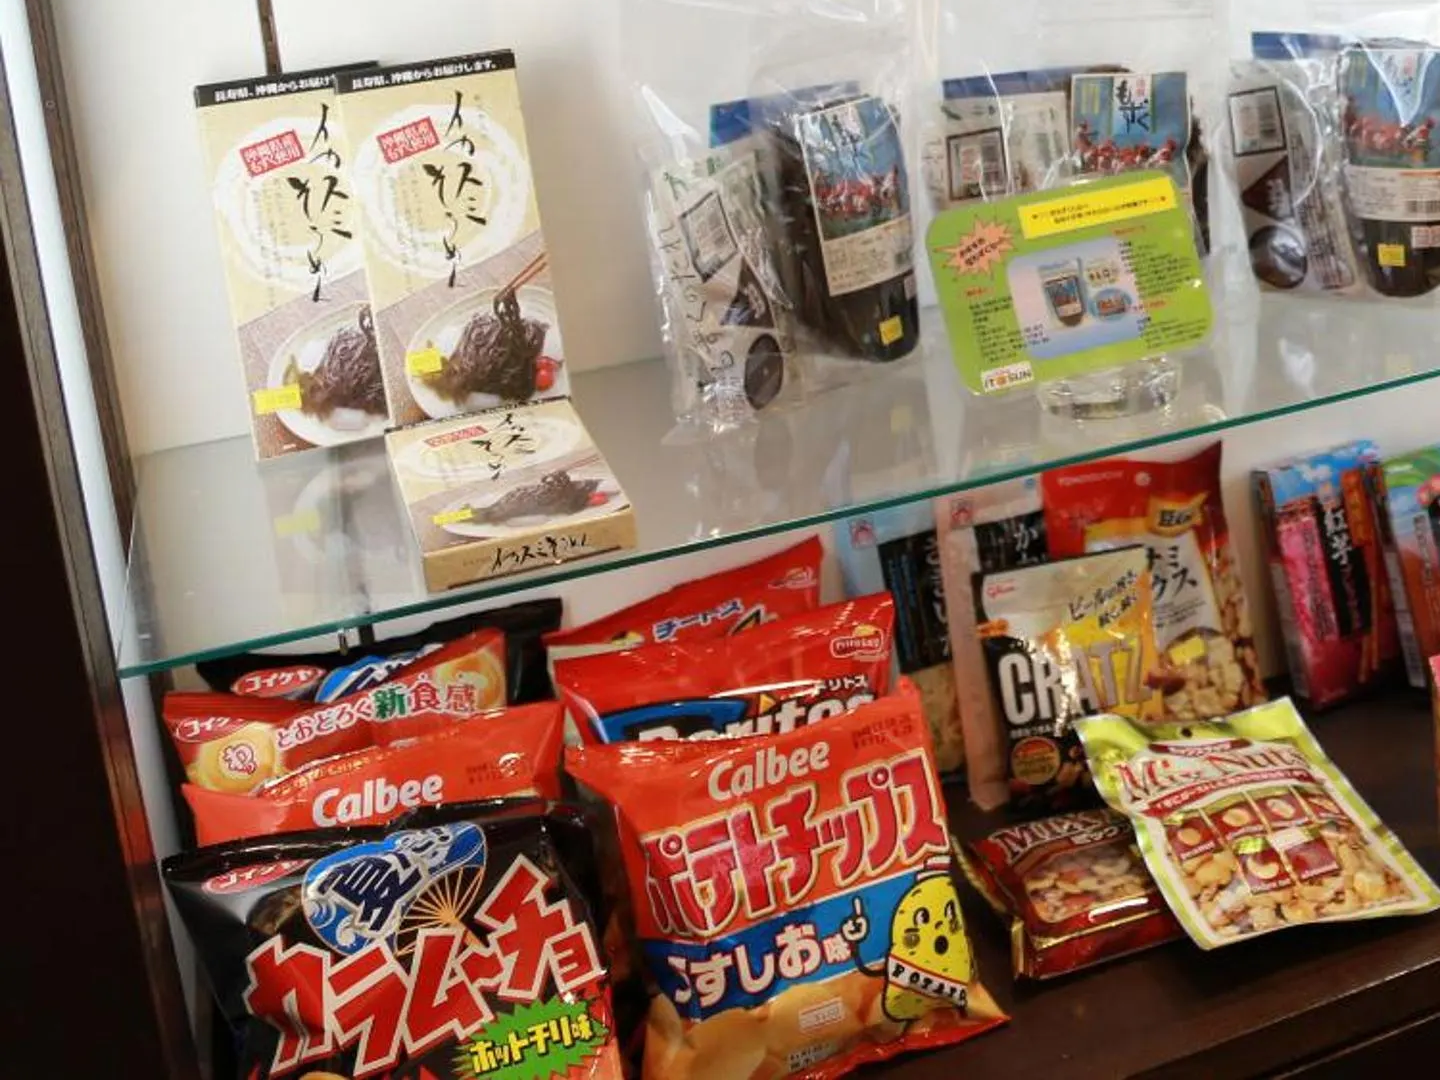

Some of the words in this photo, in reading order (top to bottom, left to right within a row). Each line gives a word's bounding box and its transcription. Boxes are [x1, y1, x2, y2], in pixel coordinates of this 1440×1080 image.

[245, 668, 315, 692] コイケヤ
[998, 638, 1155, 726] CRATZ
[312, 774, 444, 828] Calbee
[709, 741, 830, 802] Calbee
[643, 748, 950, 939] ポテトチップス
[317, 850, 423, 932] 夏
[243, 854, 605, 1078] カラムーチョ
[891, 961, 969, 1008] POTATO
[470, 1010, 596, 1074] ホットチリ味
